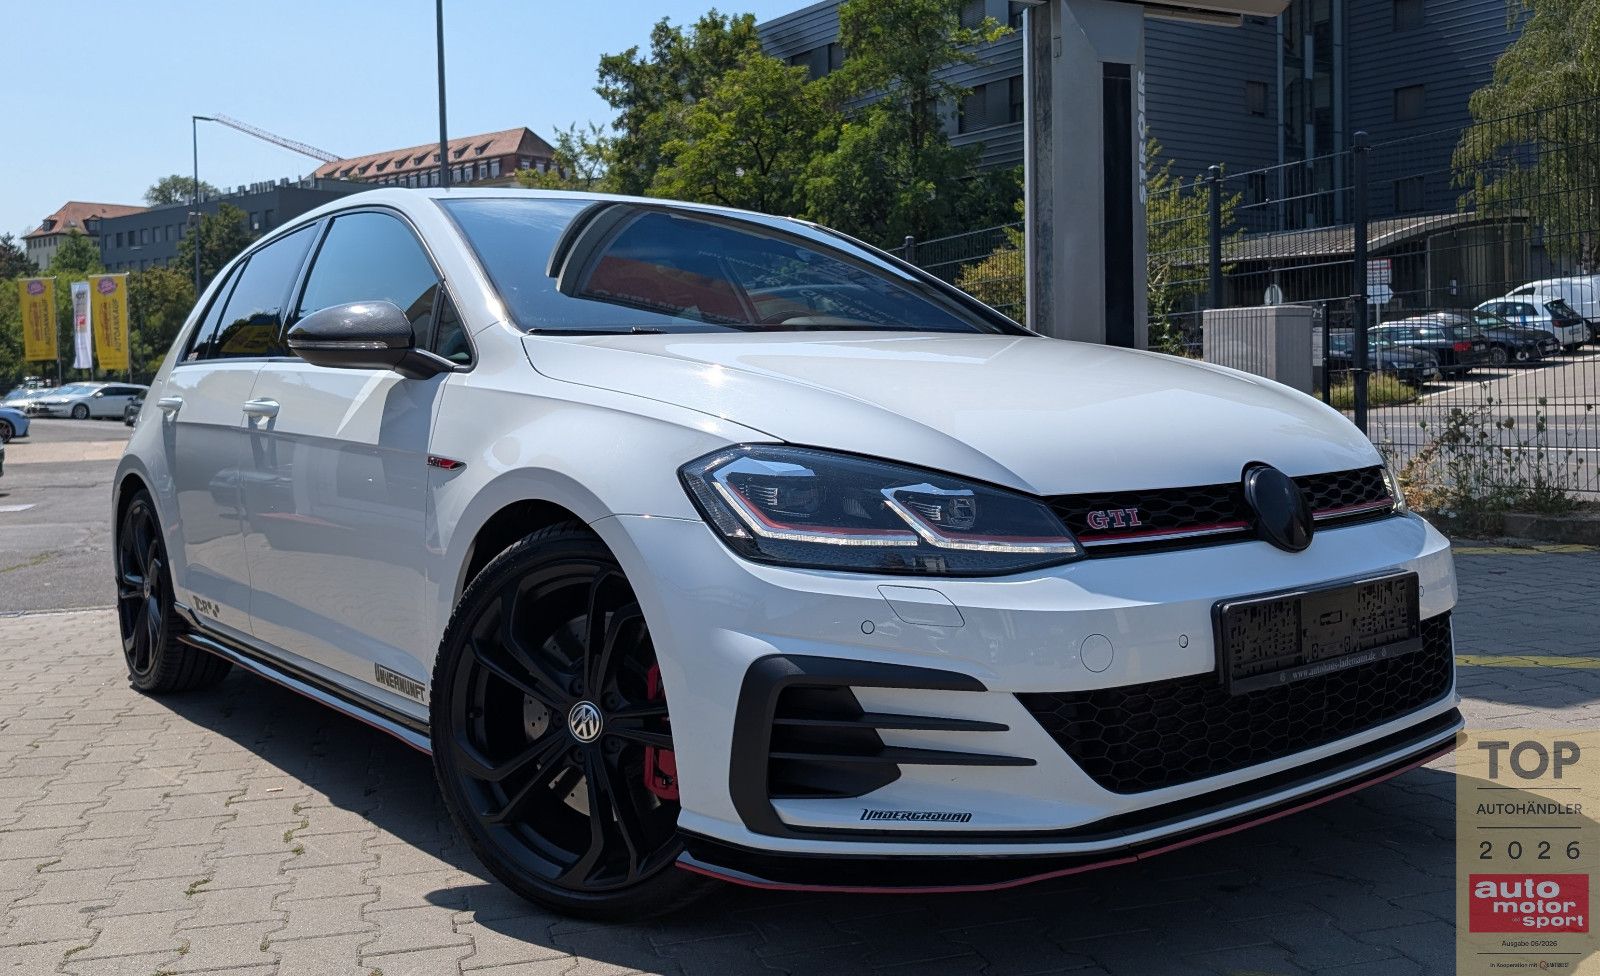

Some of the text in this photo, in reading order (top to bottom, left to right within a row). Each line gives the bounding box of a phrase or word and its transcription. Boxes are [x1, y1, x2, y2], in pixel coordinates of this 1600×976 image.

[1086, 507, 1142, 530] GTI
[375, 662, 426, 702] UNVERNUNFT
[860, 808, 973, 823] UNDERGROUND
